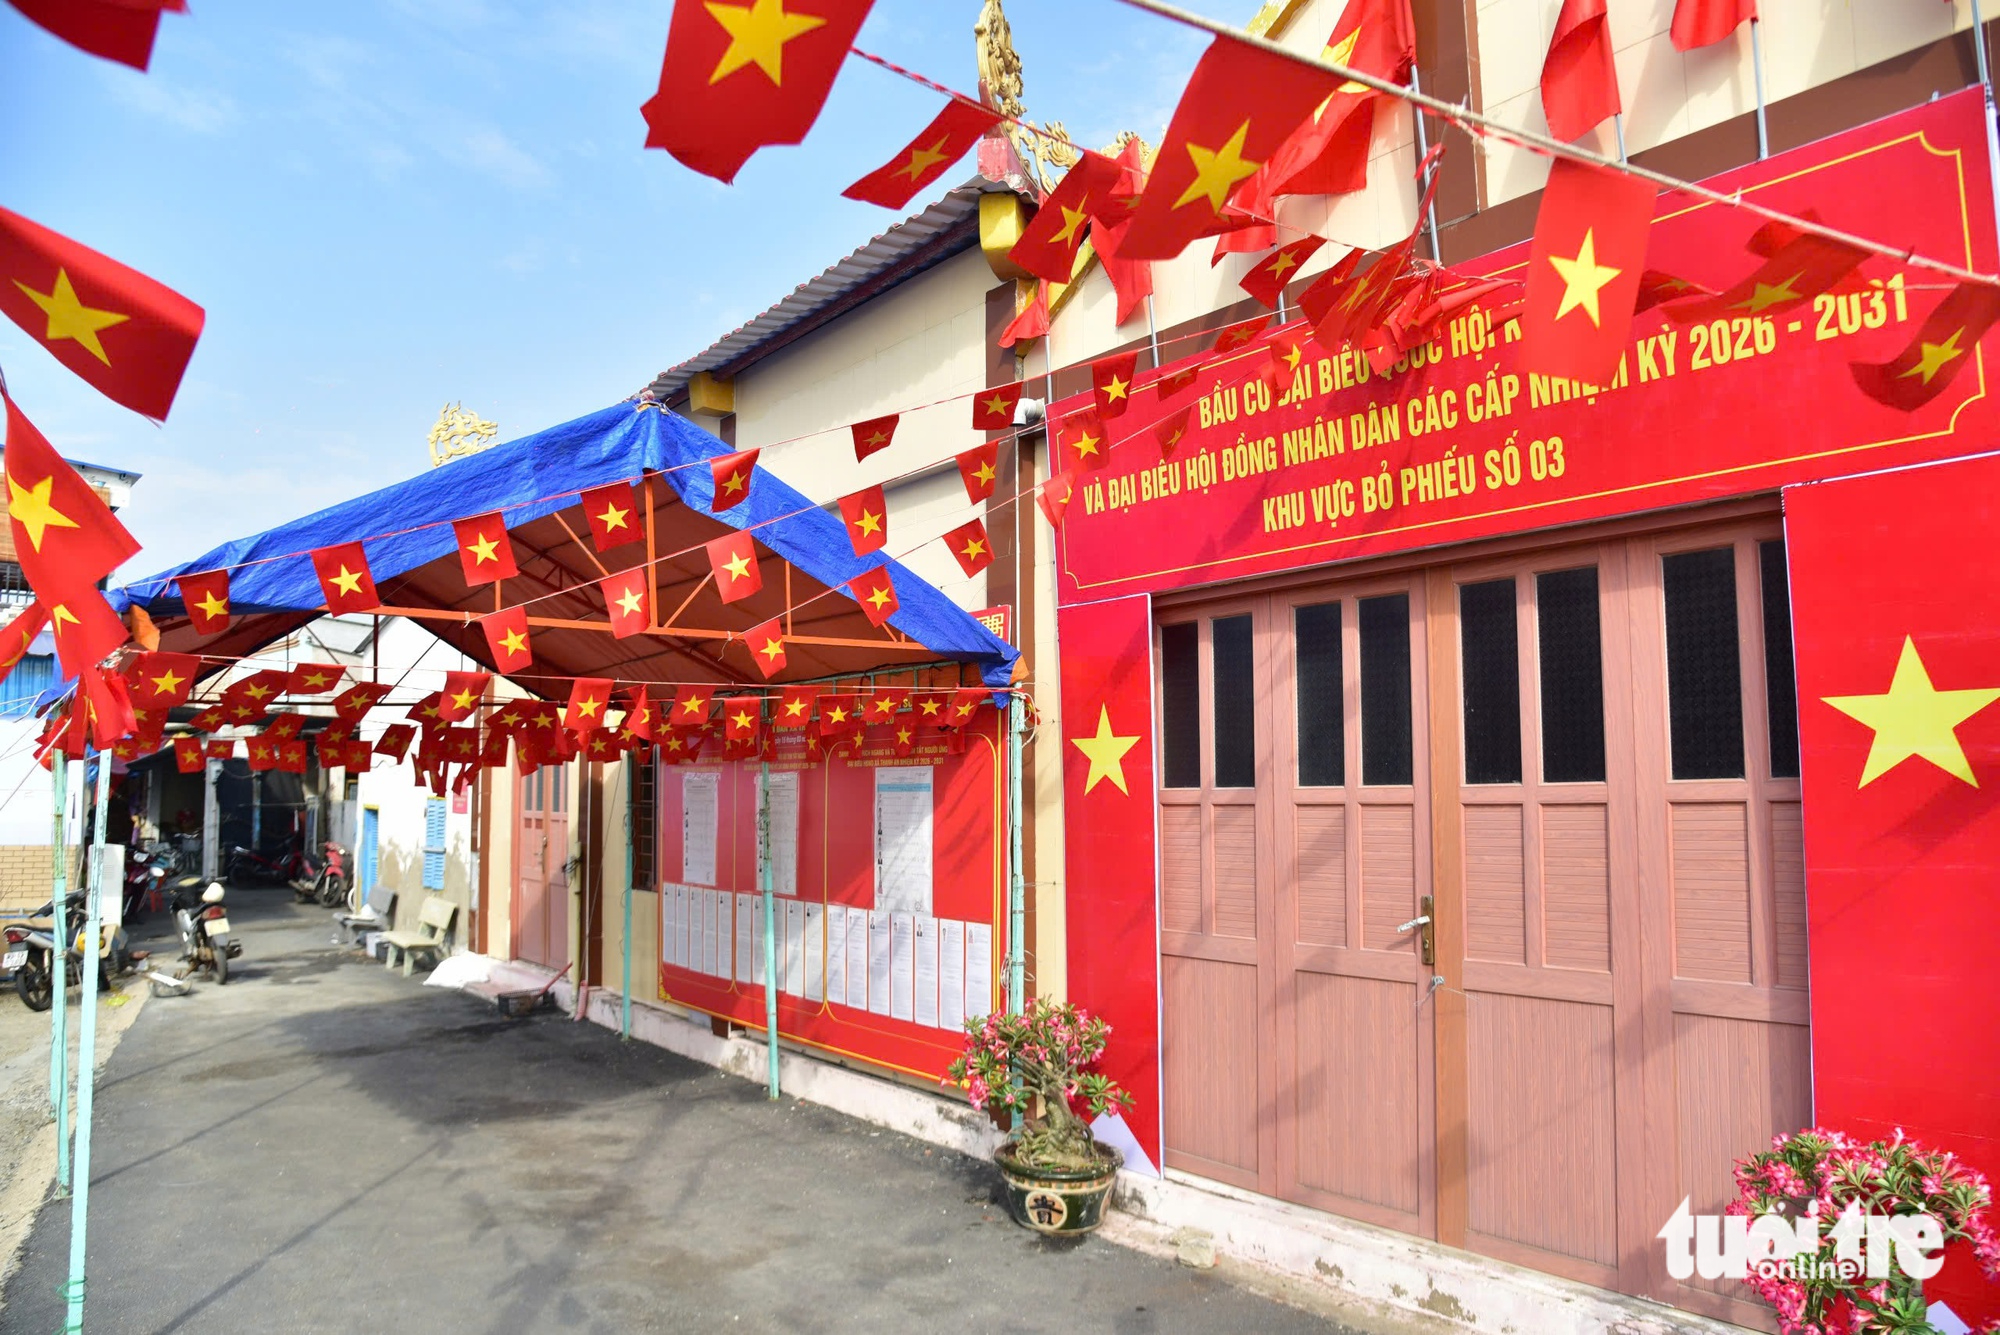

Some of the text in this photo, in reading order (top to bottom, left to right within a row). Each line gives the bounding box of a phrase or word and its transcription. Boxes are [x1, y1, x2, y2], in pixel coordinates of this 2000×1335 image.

[1082, 476, 1106, 515] VÀ
[1107, 473, 1137, 513] ĐẠI
[1185, 447, 1218, 495] HỘI
[1221, 432, 1278, 482] ĐỒNG
[1282, 415, 1345, 467] NHÂN
[1350, 401, 1401, 451] DÂN
[1407, 385, 1459, 437] CÁC
[1465, 362, 1520, 423] CẤP
[1636, 323, 1678, 383] KỲ
[1689, 314, 1777, 371] 2026
[1787, 320, 1802, 333] -
[1813, 272, 1908, 342] 2031
[1198, 379, 1238, 430] BẦU
[1262, 429, 1566, 533] KHU VỰC BỎ PHIẾU SỐ 03
